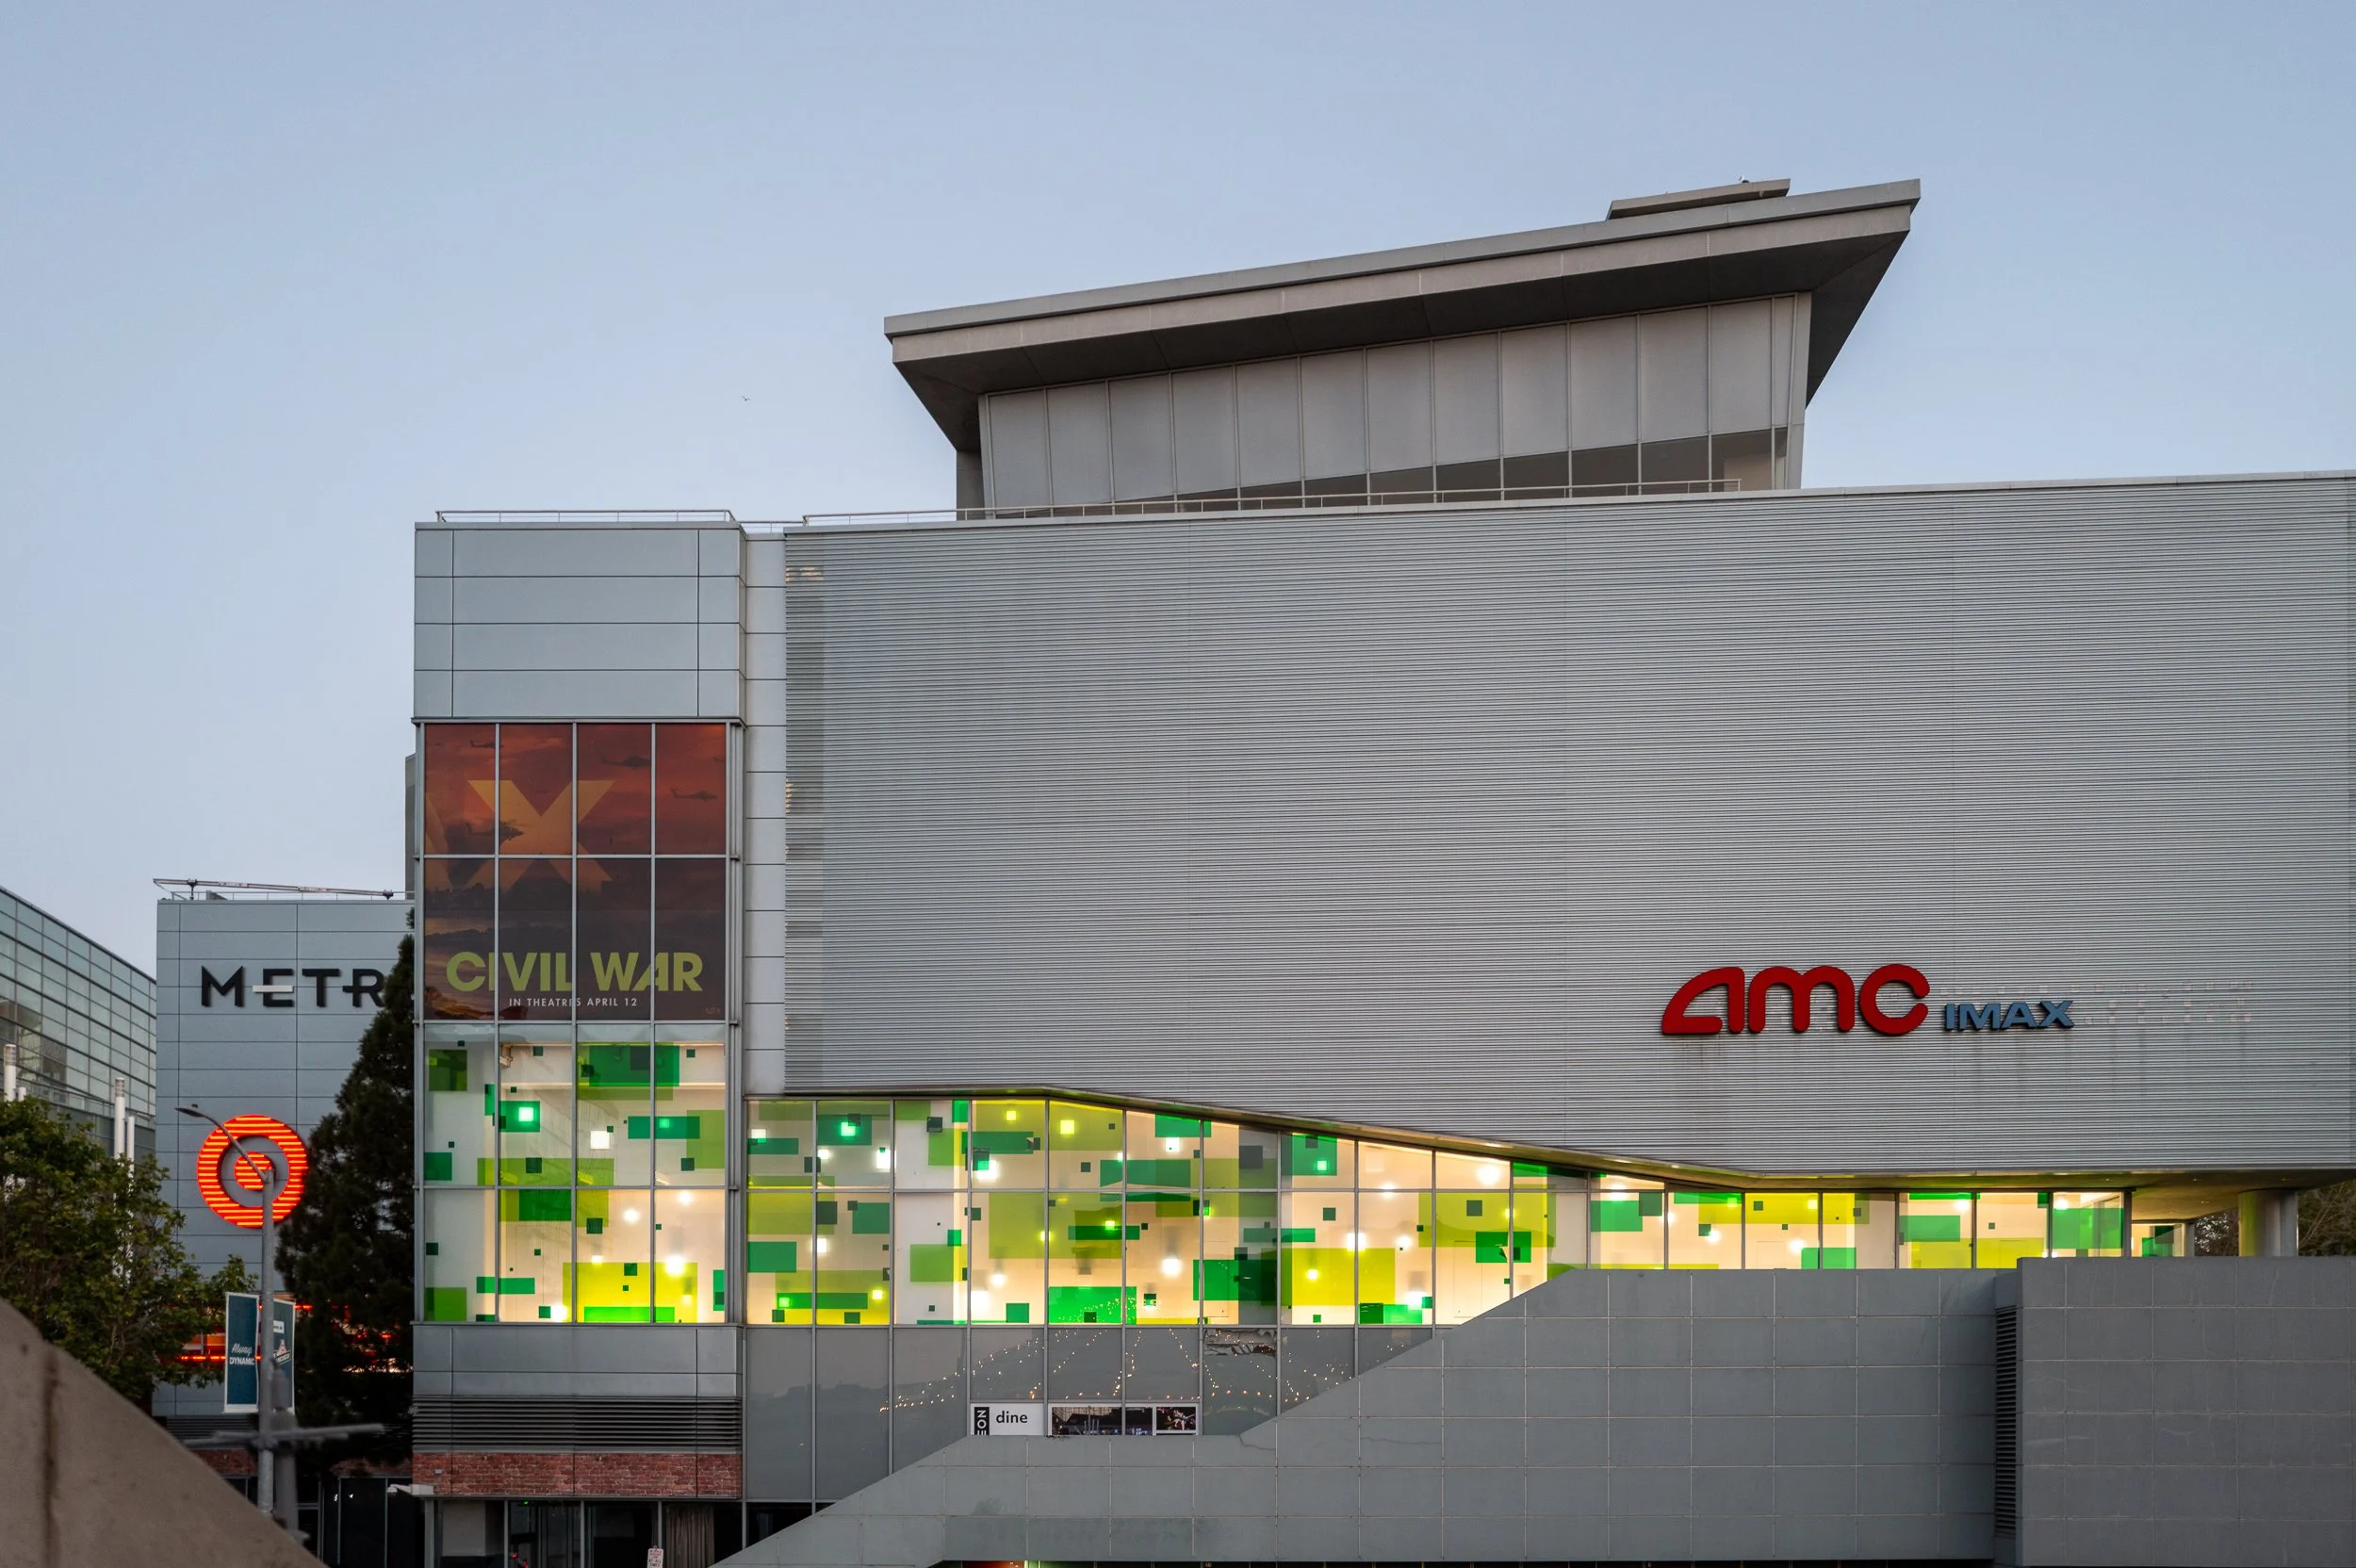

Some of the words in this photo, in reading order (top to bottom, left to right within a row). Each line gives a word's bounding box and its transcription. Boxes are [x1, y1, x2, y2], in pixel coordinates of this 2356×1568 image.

[446, 951, 572, 991] CIVIL
[590, 952, 703, 991] WAR
[509, 998, 521, 1006] IN
[527, 998, 581, 1006] THEATRES
[587, 997, 618, 1006] APRIL
[624, 997, 637, 1006] 12
[1944, 999, 2075, 1031] IMAX
[229, 1357, 254, 1365] DYNAMIC
[996, 1410, 1028, 1423] dine
